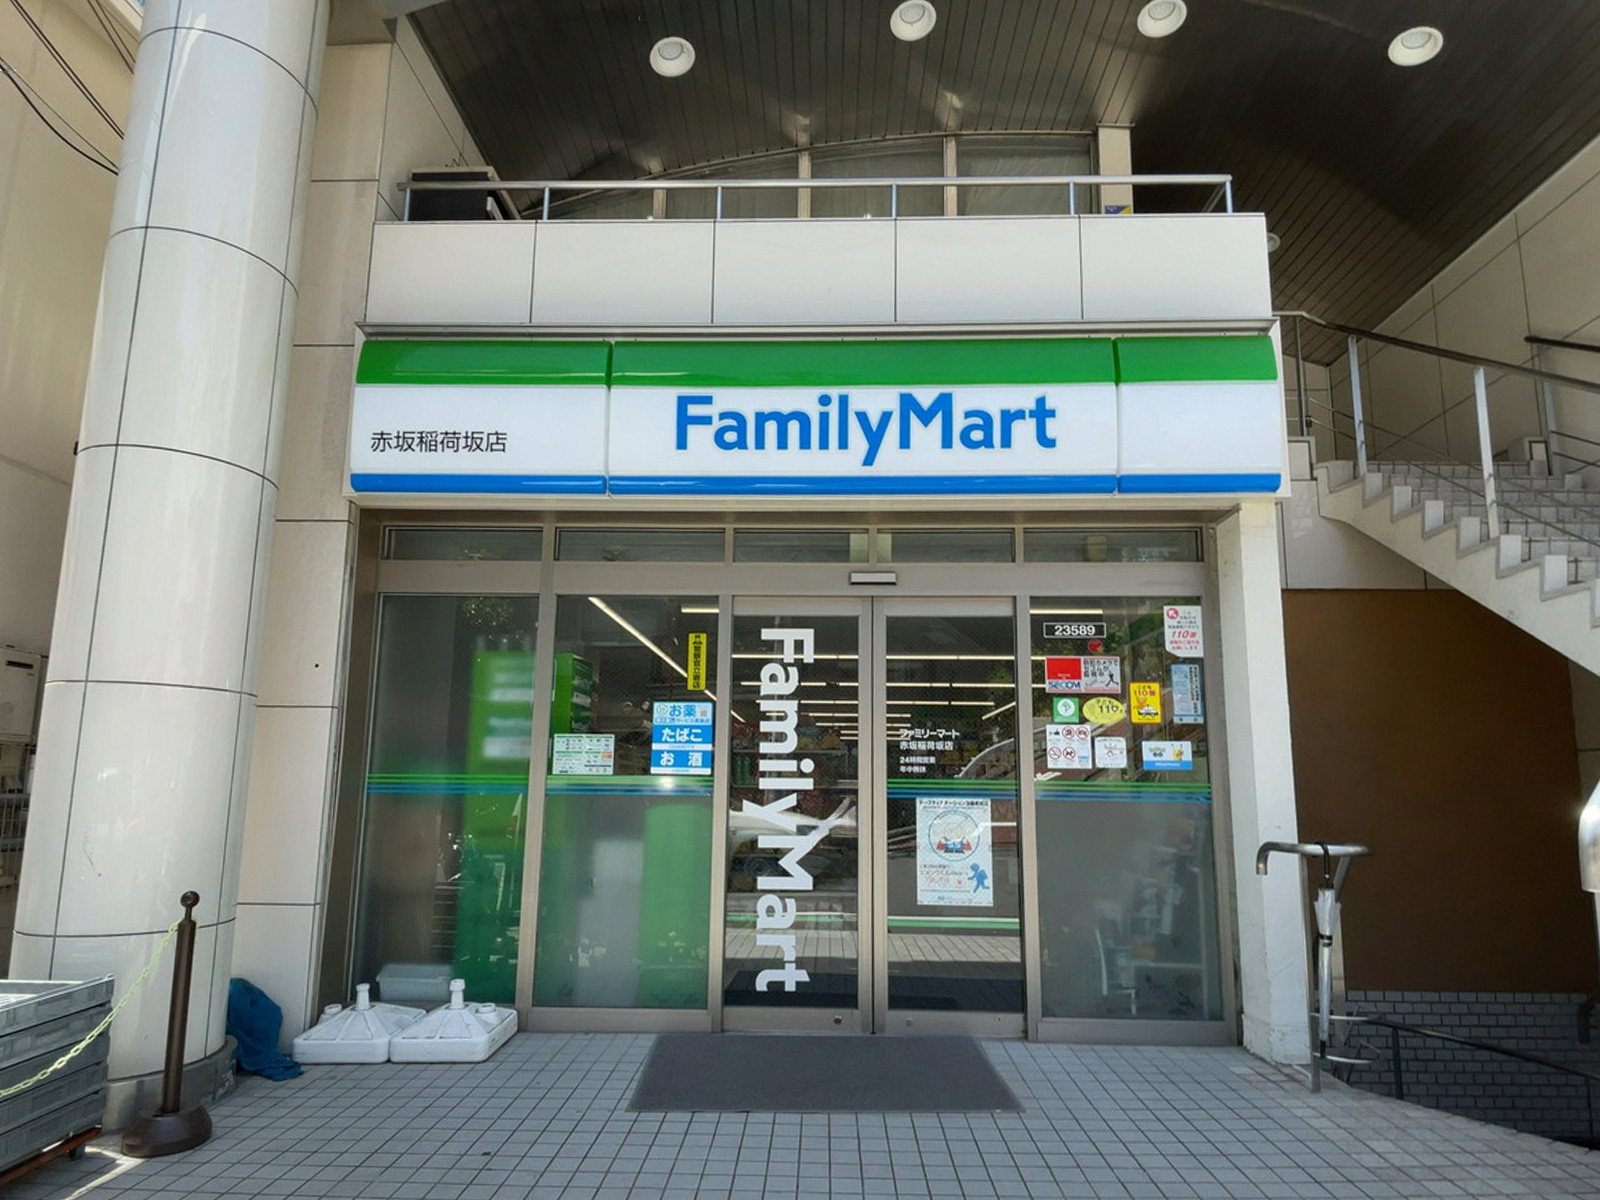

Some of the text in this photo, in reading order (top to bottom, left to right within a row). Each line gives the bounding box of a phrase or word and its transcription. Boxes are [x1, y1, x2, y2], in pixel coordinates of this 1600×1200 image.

[676, 392, 1057, 467] FamilyMart
[370, 430, 508, 453] 赤坂稲荷坂店
[1054, 625, 1096, 637] 23589
[1048, 681, 1081, 690] SECOM
[669, 704, 697, 718] お薬
[661, 727, 703, 743] たばこ
[899, 728, 960, 740] ファミリーマート
[899, 740, 954, 751] 赤坂稲荷坂店
[899, 755, 936, 765] 24時間営業
[899, 765, 927, 774] 年中無休
[742, 628, 815, 992] FamilyMart
